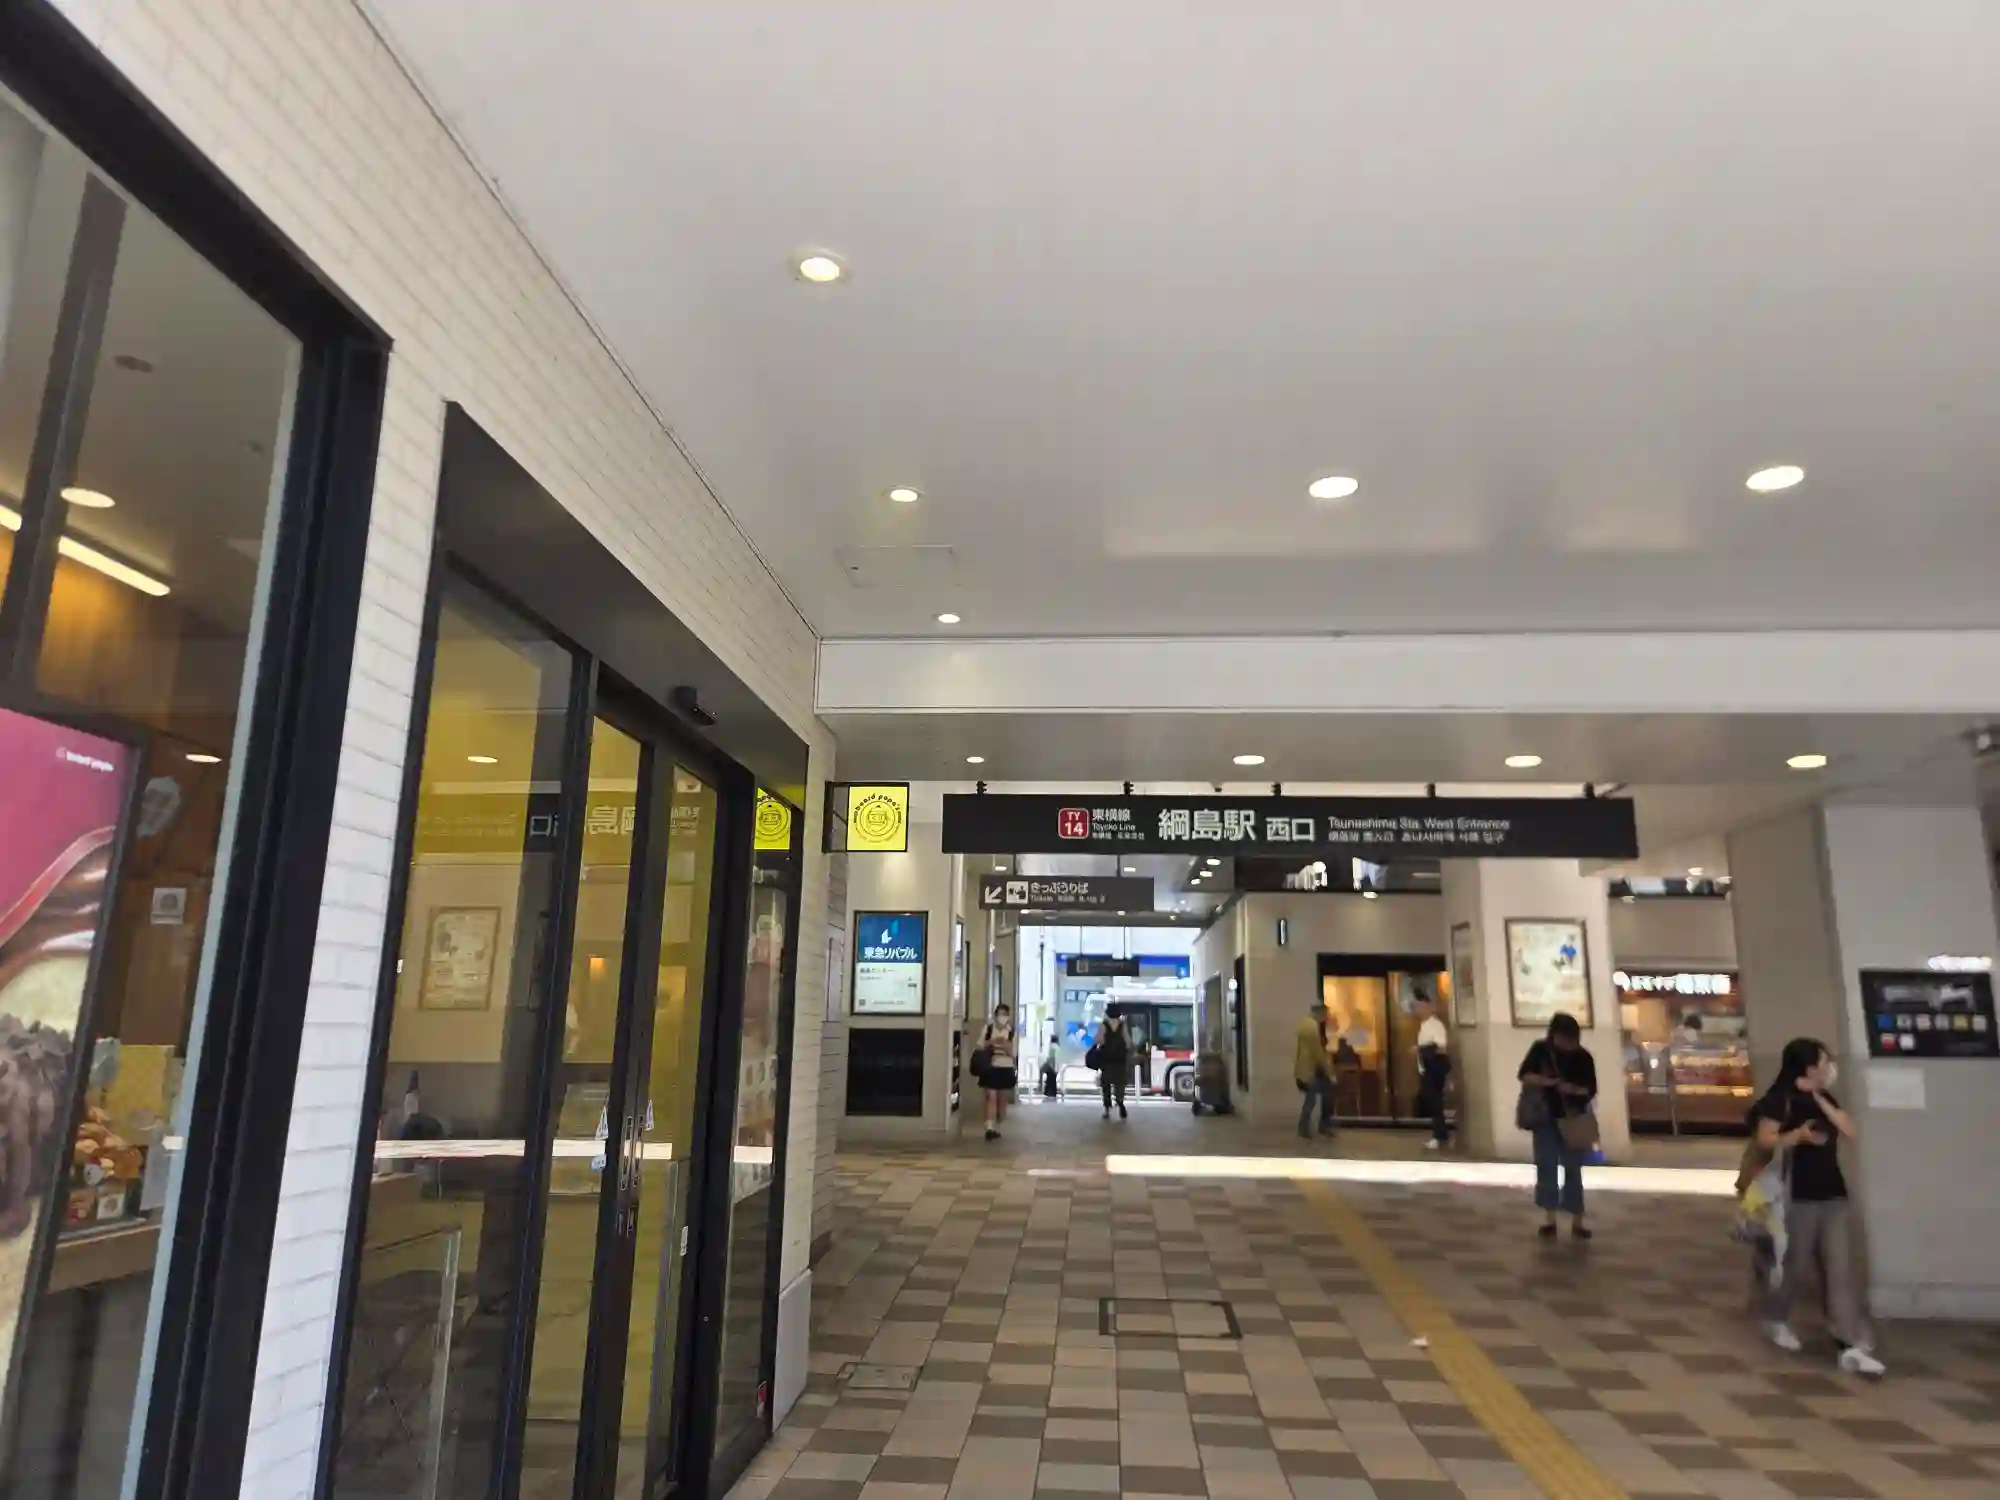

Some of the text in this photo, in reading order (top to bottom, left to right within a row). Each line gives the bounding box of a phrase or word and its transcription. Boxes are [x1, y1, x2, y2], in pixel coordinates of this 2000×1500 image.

[854, 793, 901, 812] beard papa's
[1067, 811, 1081, 821] TY
[1092, 808, 1131, 822] 東横線
[1064, 822, 1084, 836] 14
[1092, 822, 1136, 833] Toyoko Line
[1158, 808, 1315, 842] 綱島駅 西口
[1030, 882, 1089, 894] きっぷうりば
[864, 947, 918, 960] 東急リバブル
